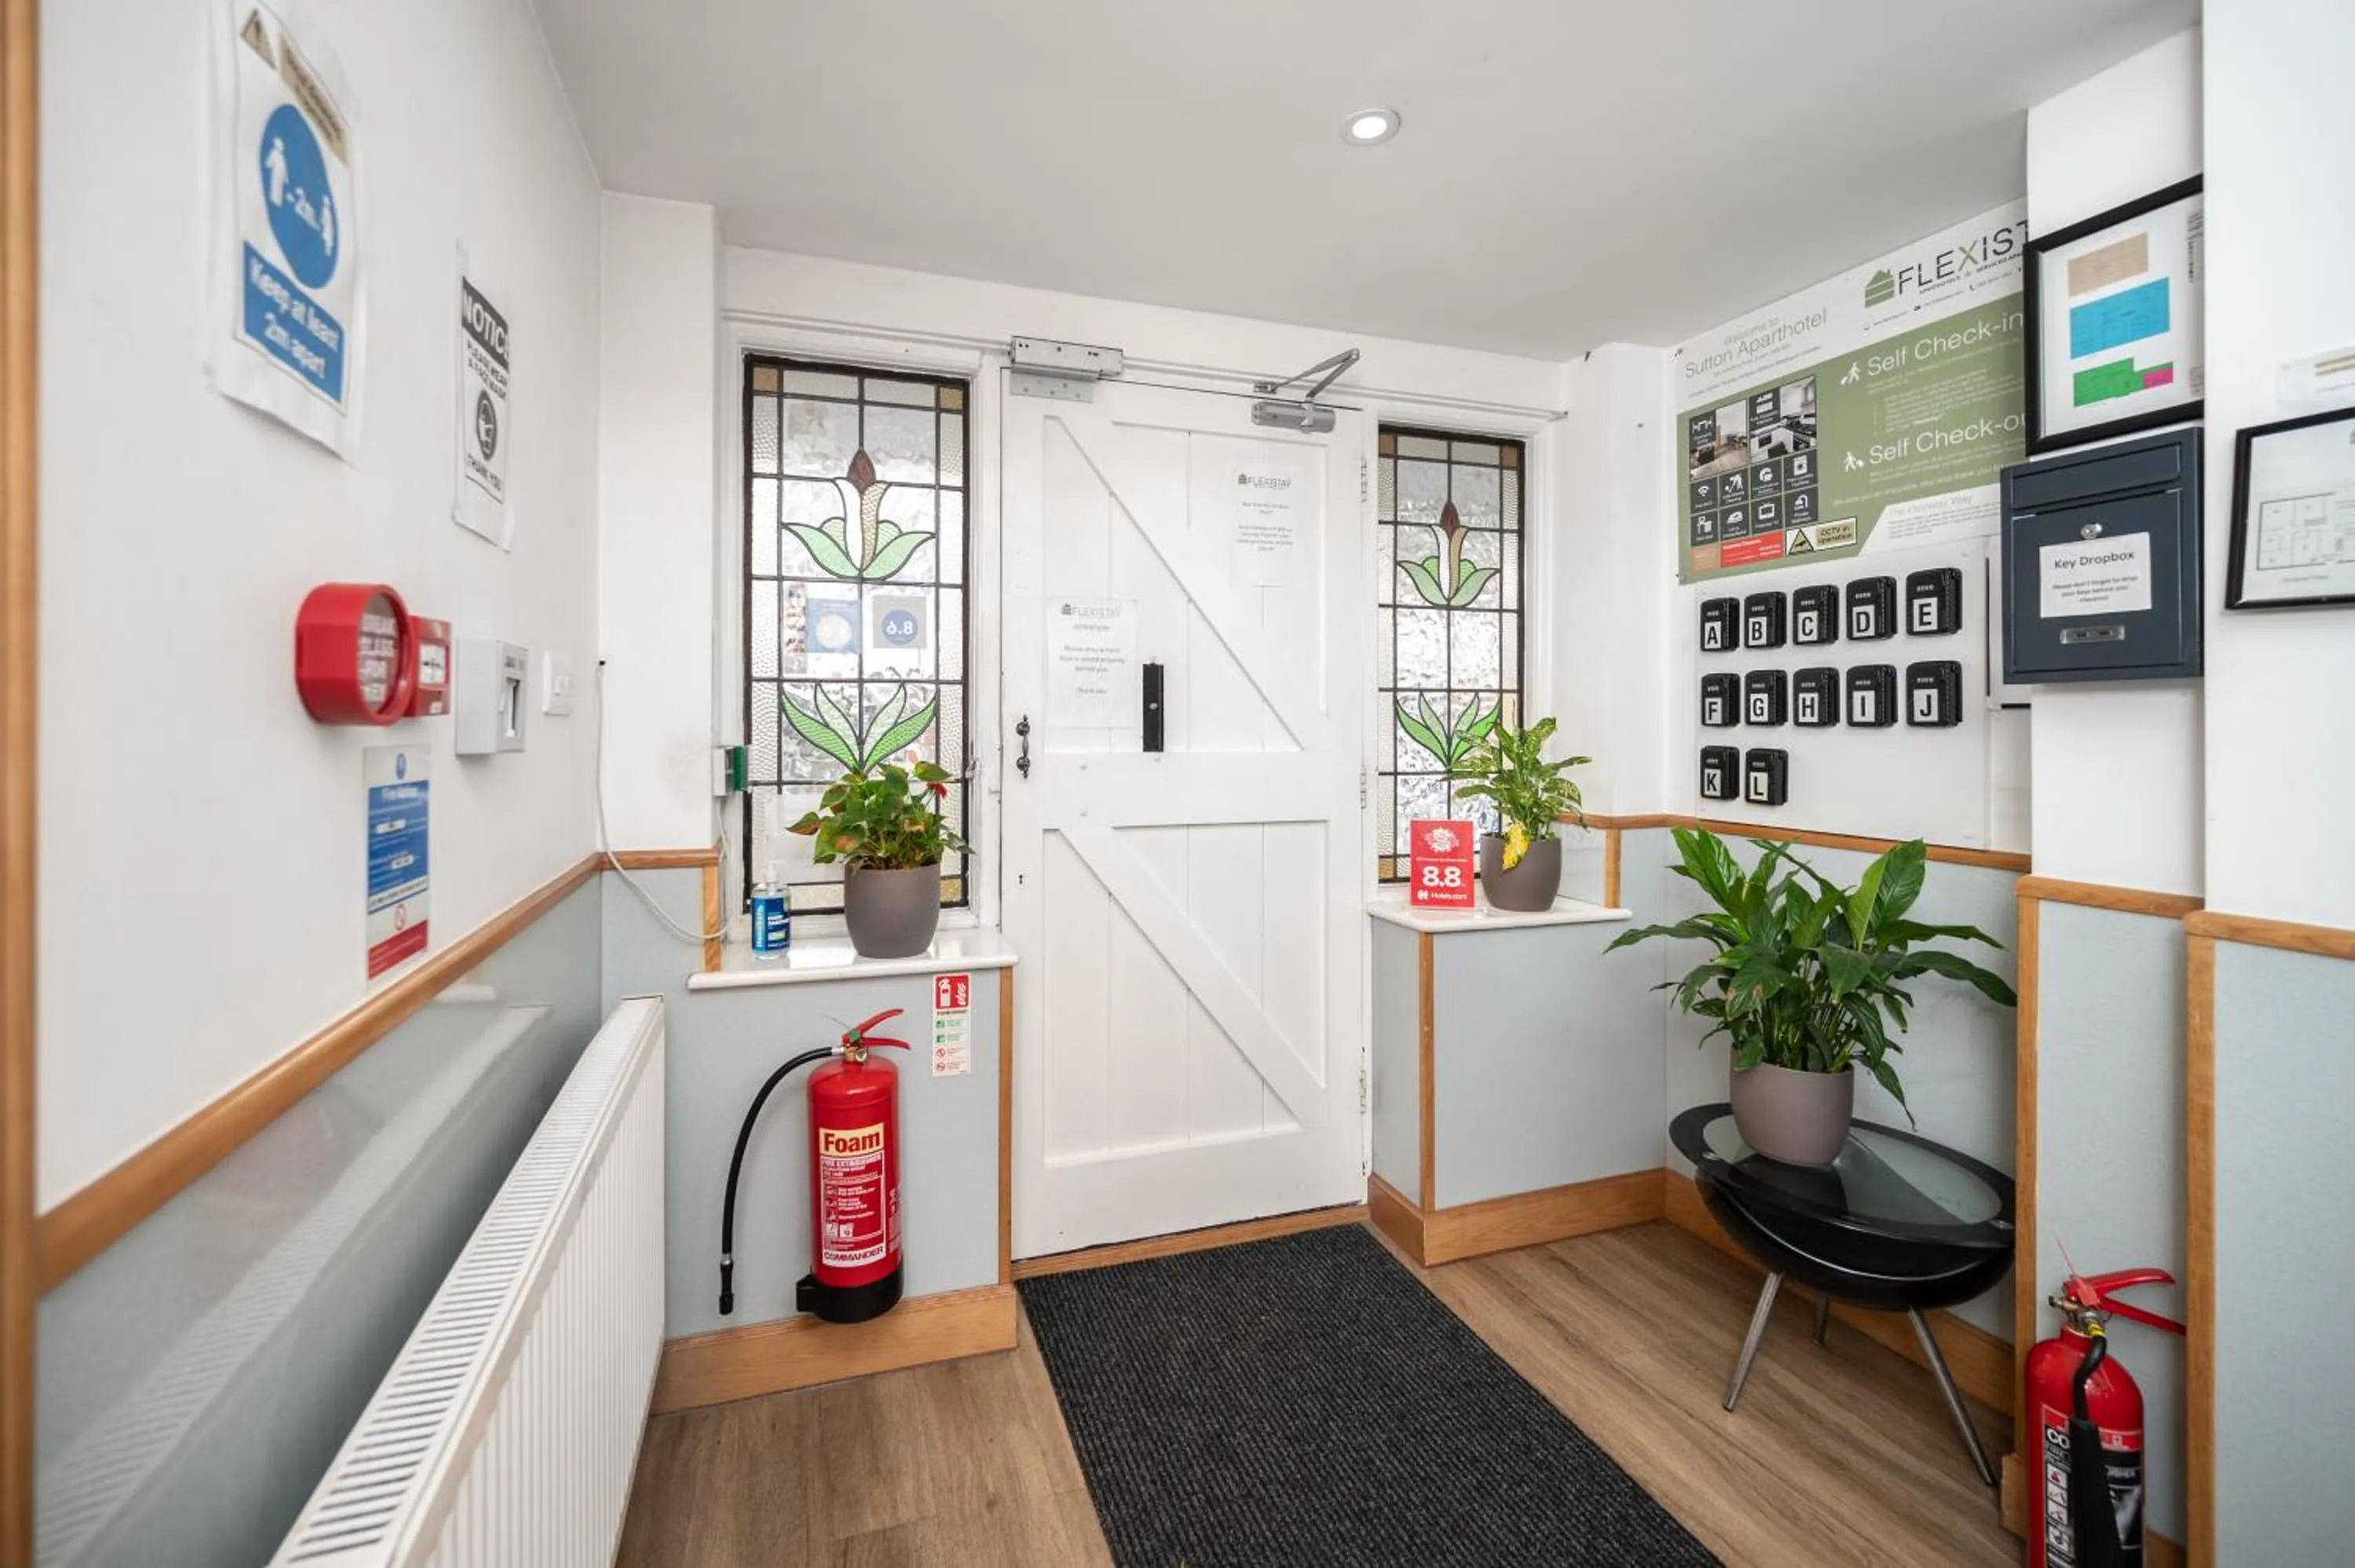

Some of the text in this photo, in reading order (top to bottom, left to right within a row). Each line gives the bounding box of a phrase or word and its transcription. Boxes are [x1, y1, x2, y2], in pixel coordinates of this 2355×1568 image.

[250, 257, 339, 352] Keep at least
[264, 311, 327, 379] 2m apart
[1685, 350, 1732, 379] Sutton
[1738, 306, 1827, 356] Aparthotel
[1867, 345, 1908, 376] Self
[1915, 311, 2024, 360] Check-in
[1869, 437, 1911, 465] Self
[1820, 527, 1841, 536] CCTV
[2054, 552, 2134, 571] Key Dropbox
[1801, 615, 1814, 637] C
[1856, 610, 1871, 634] D
[1918, 602, 1933, 628] E
[1706, 625, 1719, 646] A
[1751, 620, 1764, 642] B
[1707, 700, 1719, 721] F
[1752, 697, 1765, 718] G
[1801, 695, 1816, 719] H
[1860, 695, 1867, 718] I
[1919, 693, 1933, 718] J
[1705, 771, 1718, 793] K
[1753, 775, 1765, 797] L
[1422, 866, 1461, 888] 8.8
[824, 1132, 880, 1153] Foam
[824, 1245, 884, 1261] COMMANDER
